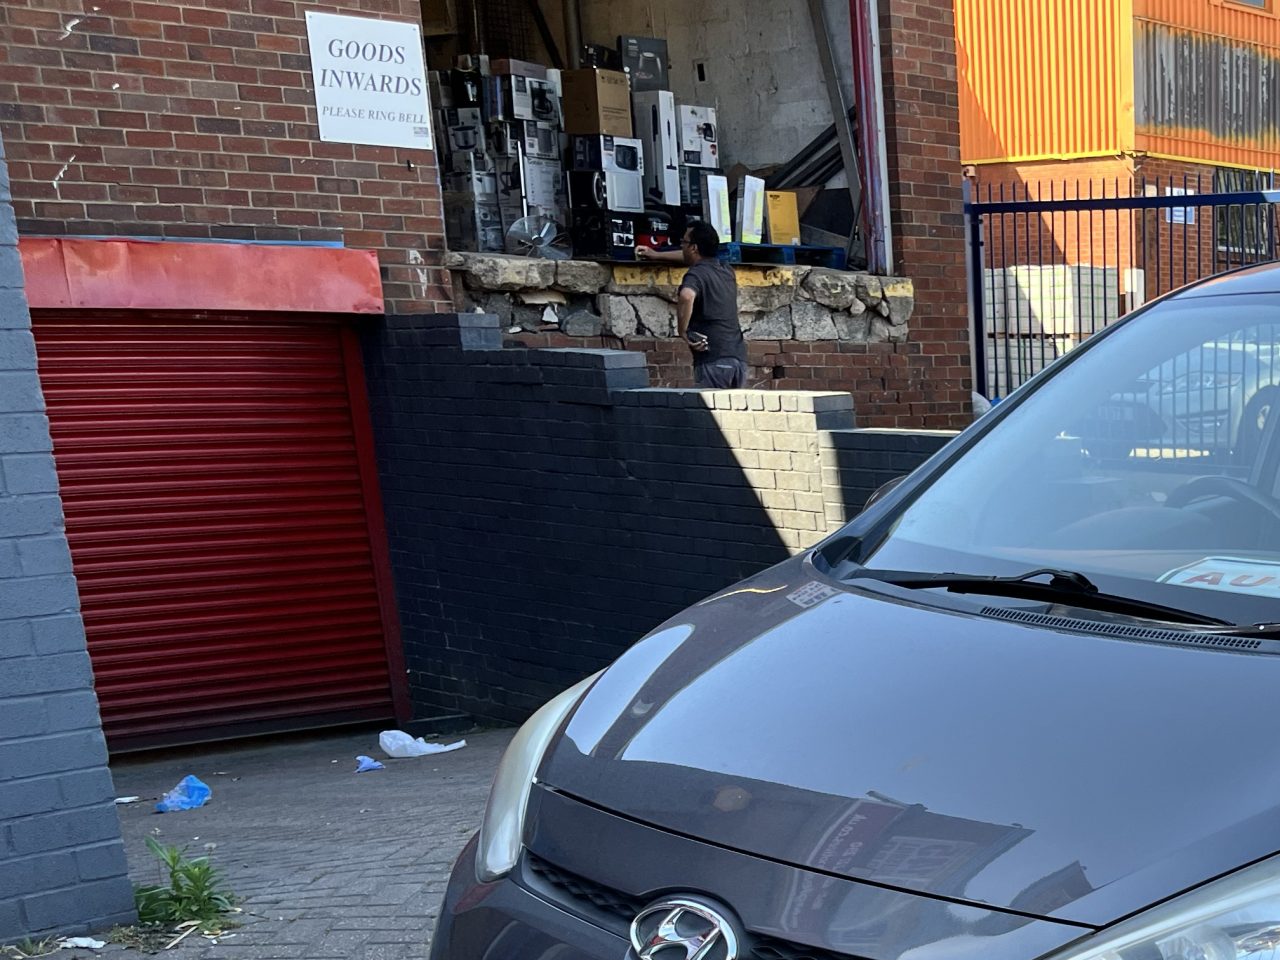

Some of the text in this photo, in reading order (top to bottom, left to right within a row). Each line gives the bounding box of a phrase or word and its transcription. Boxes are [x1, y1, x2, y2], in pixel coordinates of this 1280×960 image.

[328, 38, 405, 65] GOODS
[320, 68, 422, 97] INWARDS
[322, 105, 427, 124] PLEASE RING BELL
